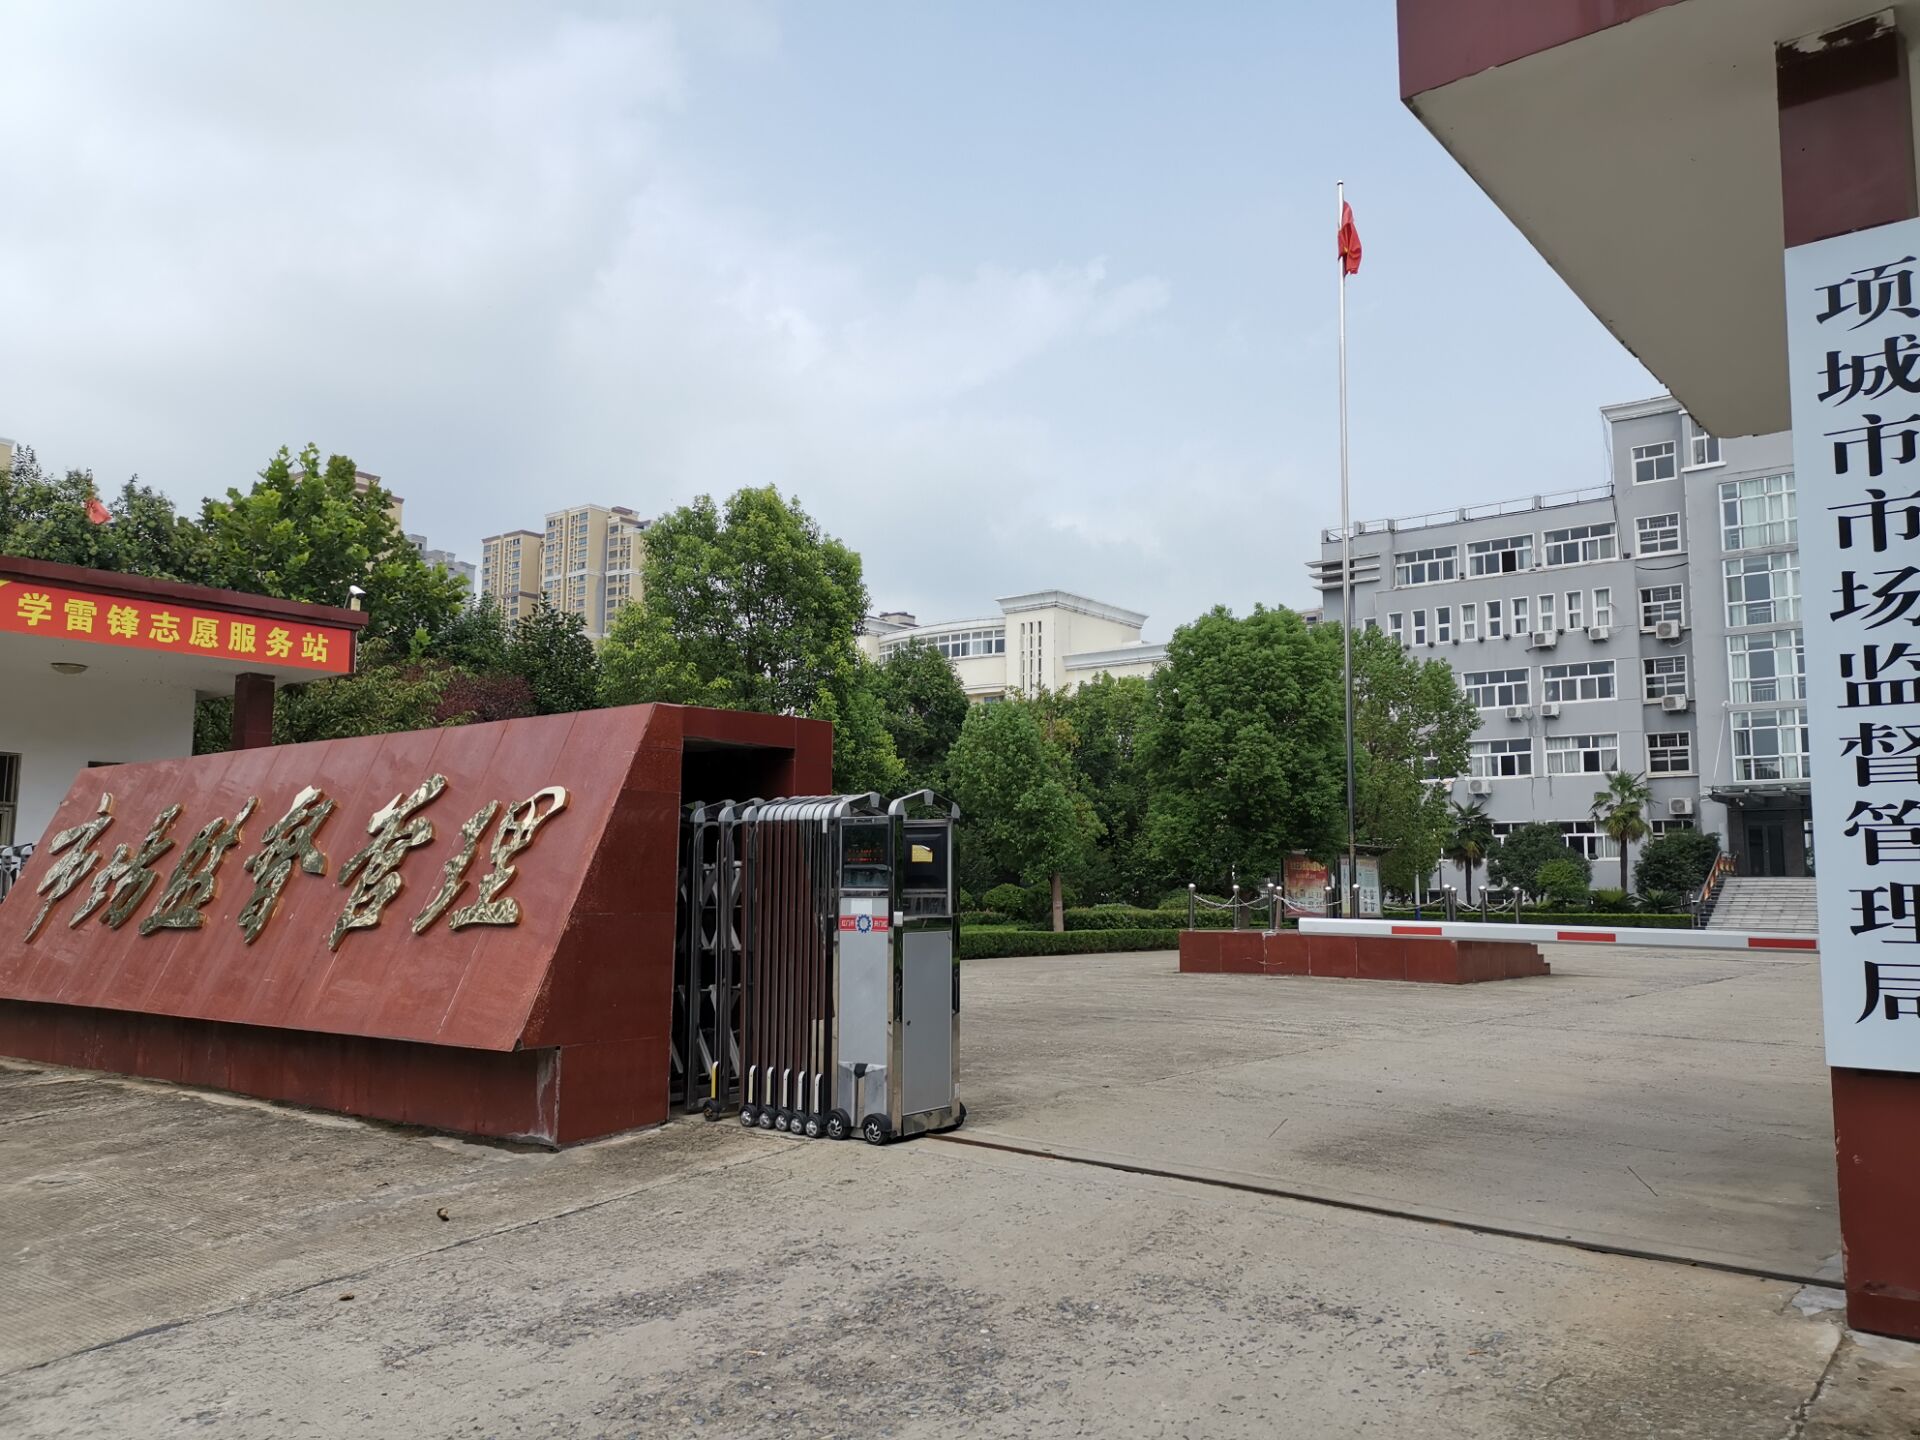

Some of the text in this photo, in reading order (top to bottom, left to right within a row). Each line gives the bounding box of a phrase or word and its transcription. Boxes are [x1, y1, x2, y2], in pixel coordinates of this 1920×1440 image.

[17, 592, 329, 663] 学雷锋志愿服务站
[1814, 256, 1920, 1024] 项城市市场监督管理局
[25, 773, 570, 951] 市场监督管理
